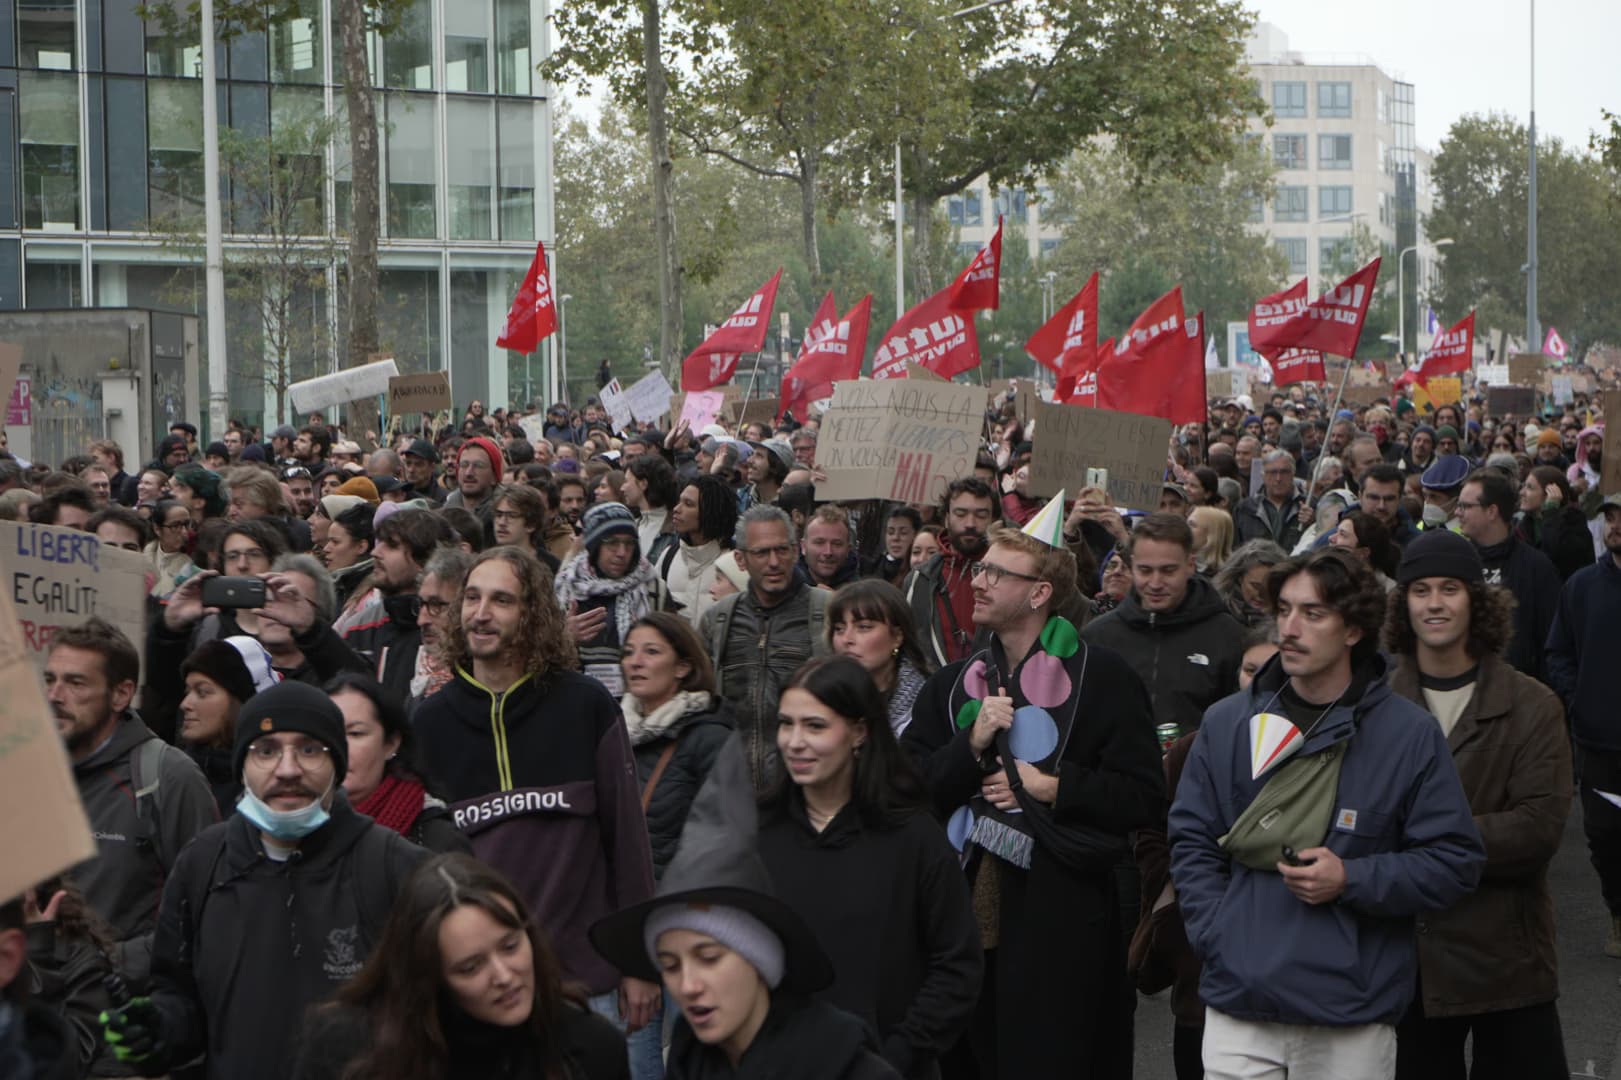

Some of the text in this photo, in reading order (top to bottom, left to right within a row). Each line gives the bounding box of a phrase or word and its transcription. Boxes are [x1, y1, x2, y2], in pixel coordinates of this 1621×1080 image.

[886, 388, 936, 421] NOUS
[945, 393, 971, 425] LA
[827, 416, 880, 442] METTEZ
[850, 447, 881, 467] VOUS
[882, 447, 896, 467] LA
[890, 452, 934, 504] MAI
